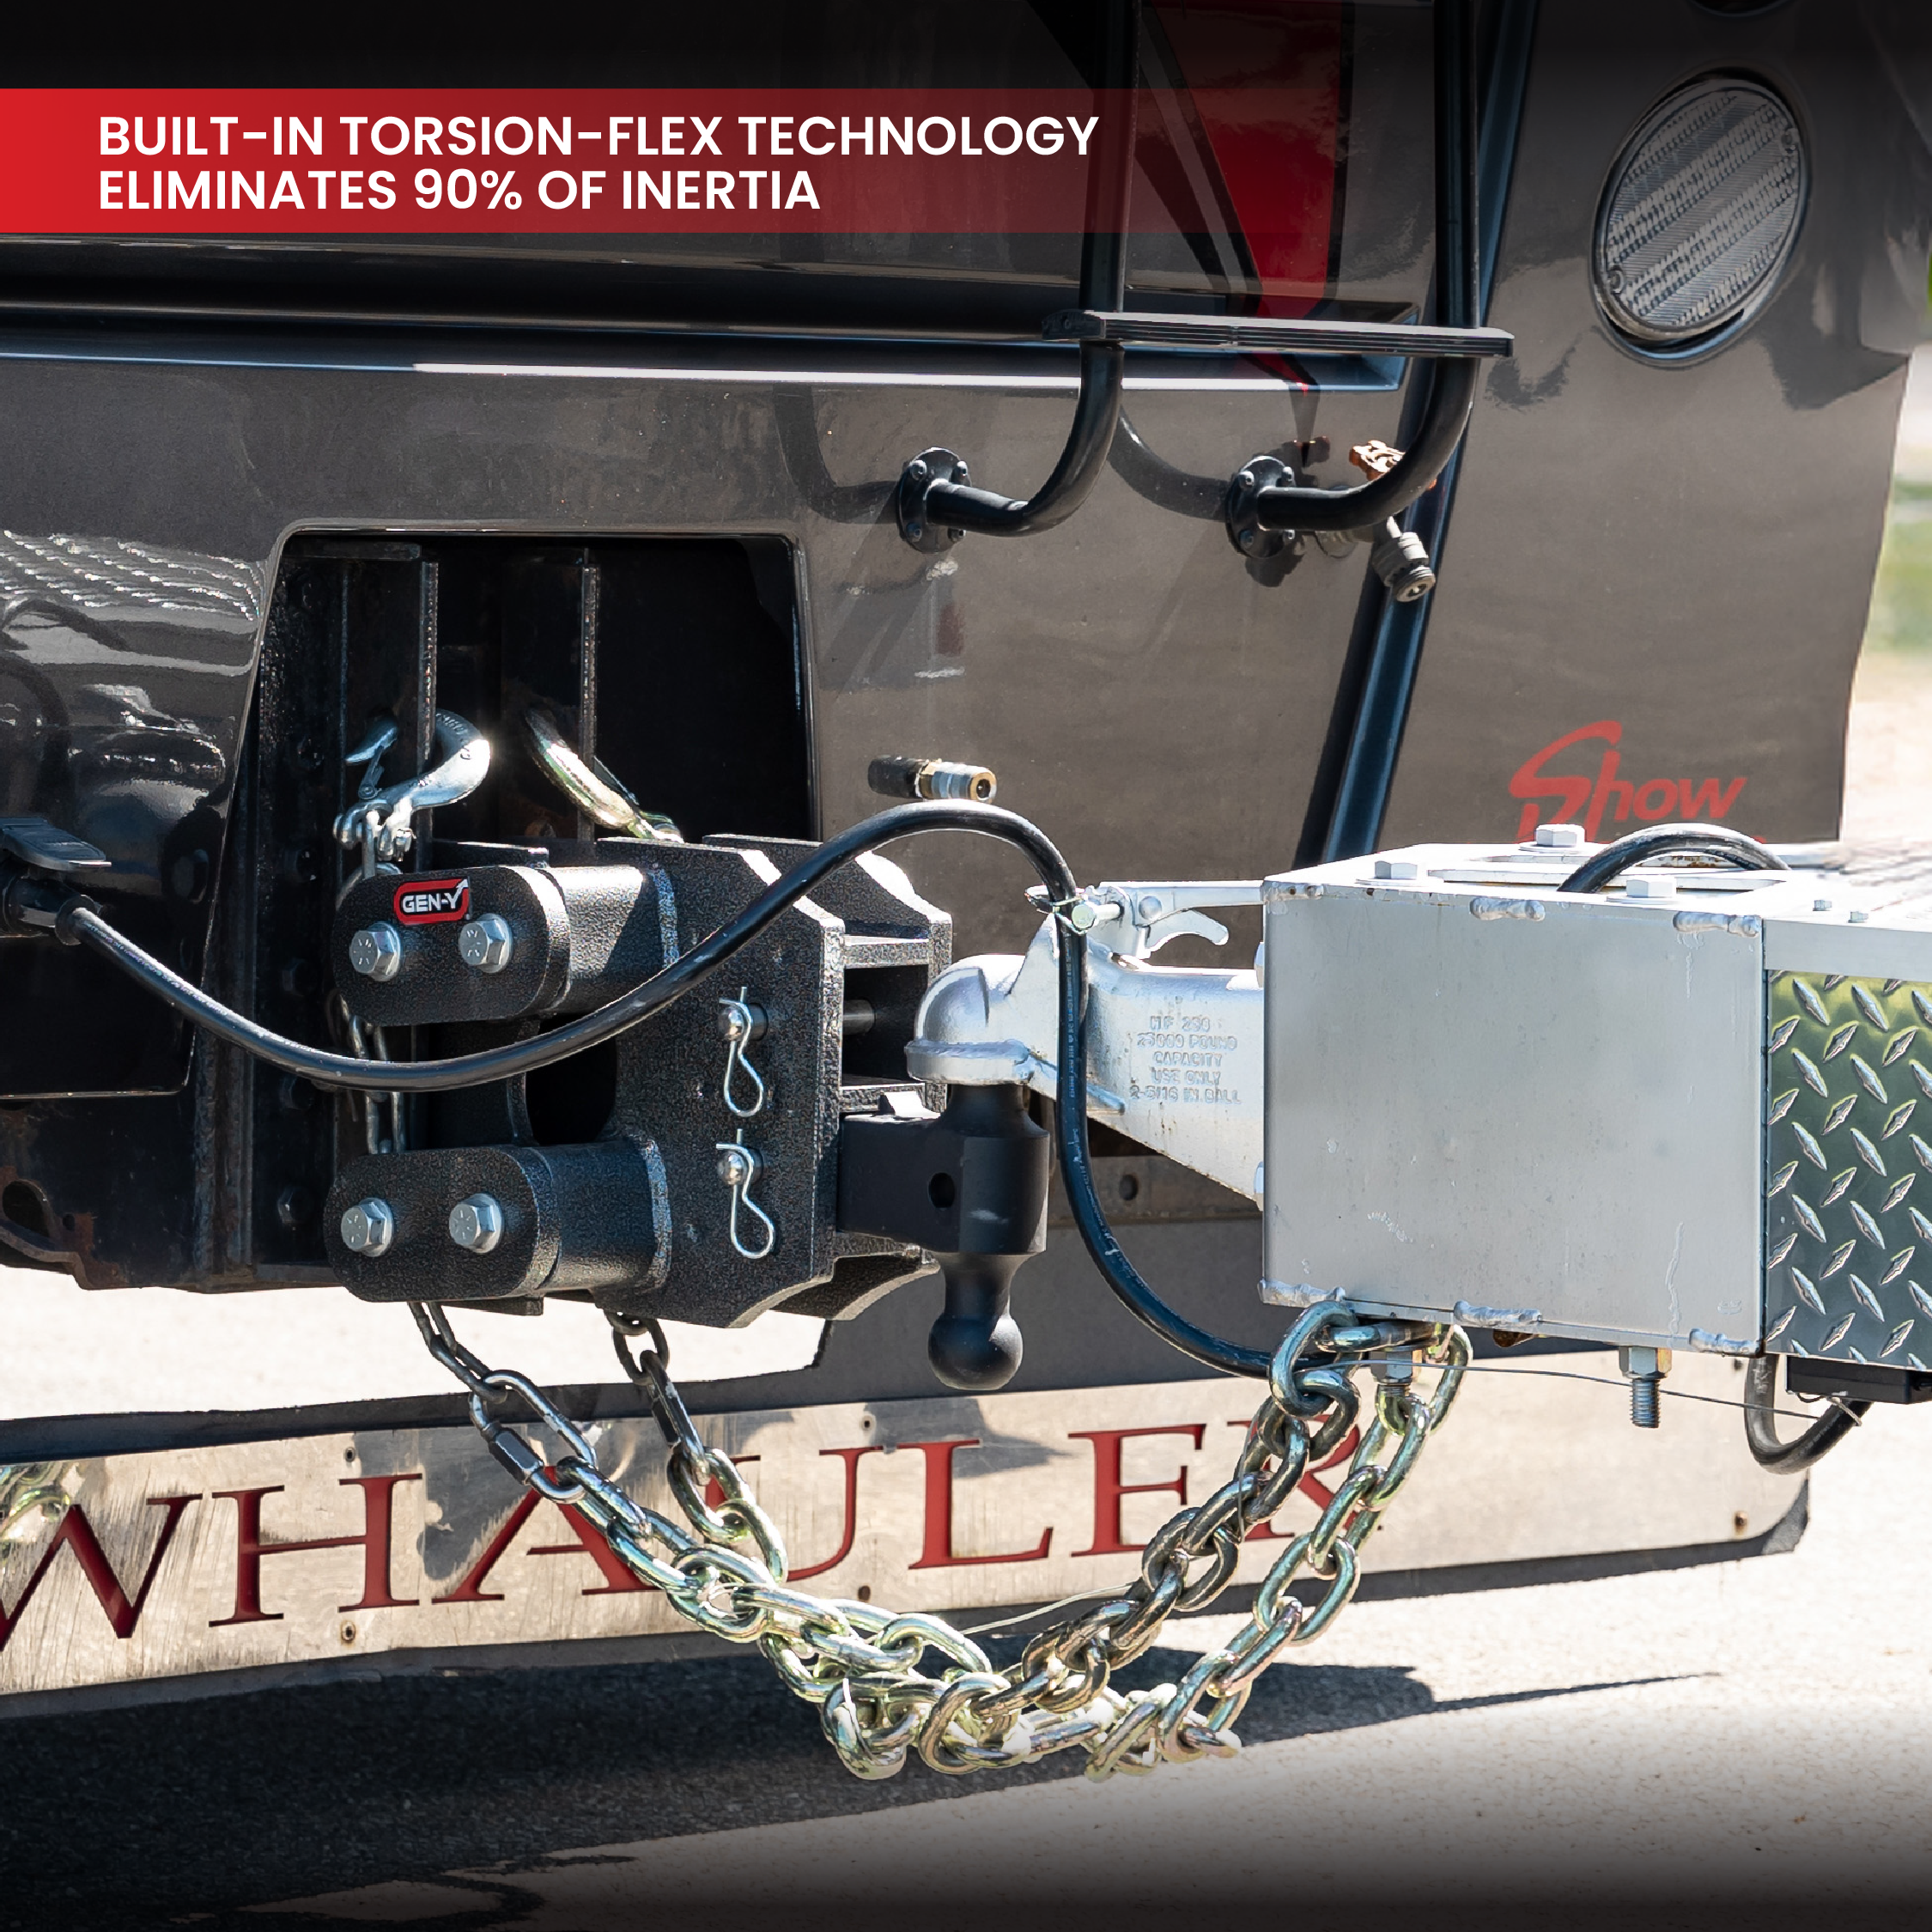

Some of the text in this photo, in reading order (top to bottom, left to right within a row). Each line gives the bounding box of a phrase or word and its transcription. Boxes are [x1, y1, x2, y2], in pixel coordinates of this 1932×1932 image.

[1509, 720, 1747, 841] Show
[402, 879, 468, 913] GEN-Y
[1188, 1034, 1237, 1050] POUND
[1153, 1051, 1222, 1066] CAPACITY
[1151, 1068, 1221, 1085] USE ONLY
[1205, 1088, 1242, 1104] BALL
